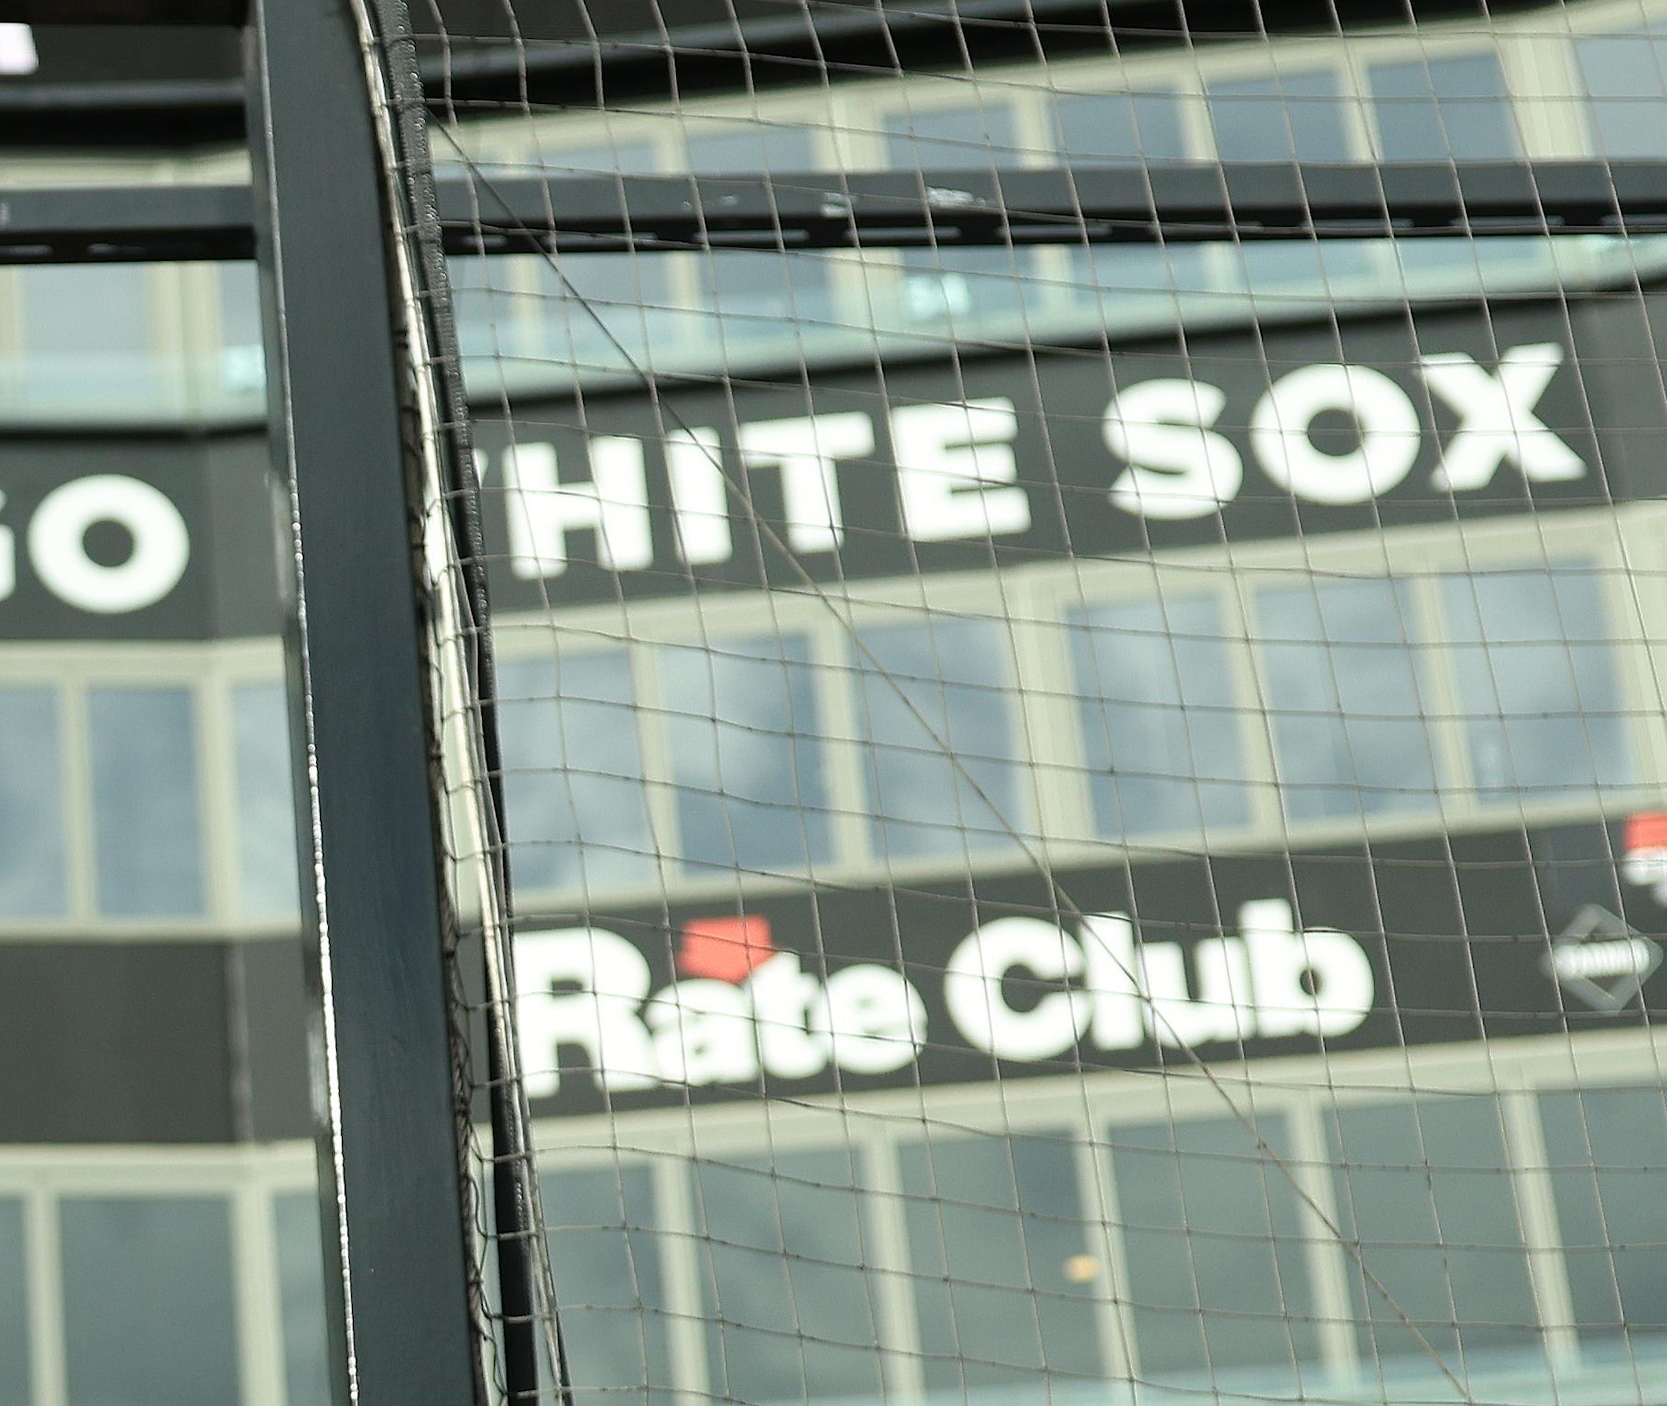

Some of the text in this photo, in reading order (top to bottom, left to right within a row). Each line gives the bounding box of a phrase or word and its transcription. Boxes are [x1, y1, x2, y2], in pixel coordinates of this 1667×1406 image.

[474, 341, 1589, 580] HITE SOX
[513, 899, 1375, 1099] Rate Club
